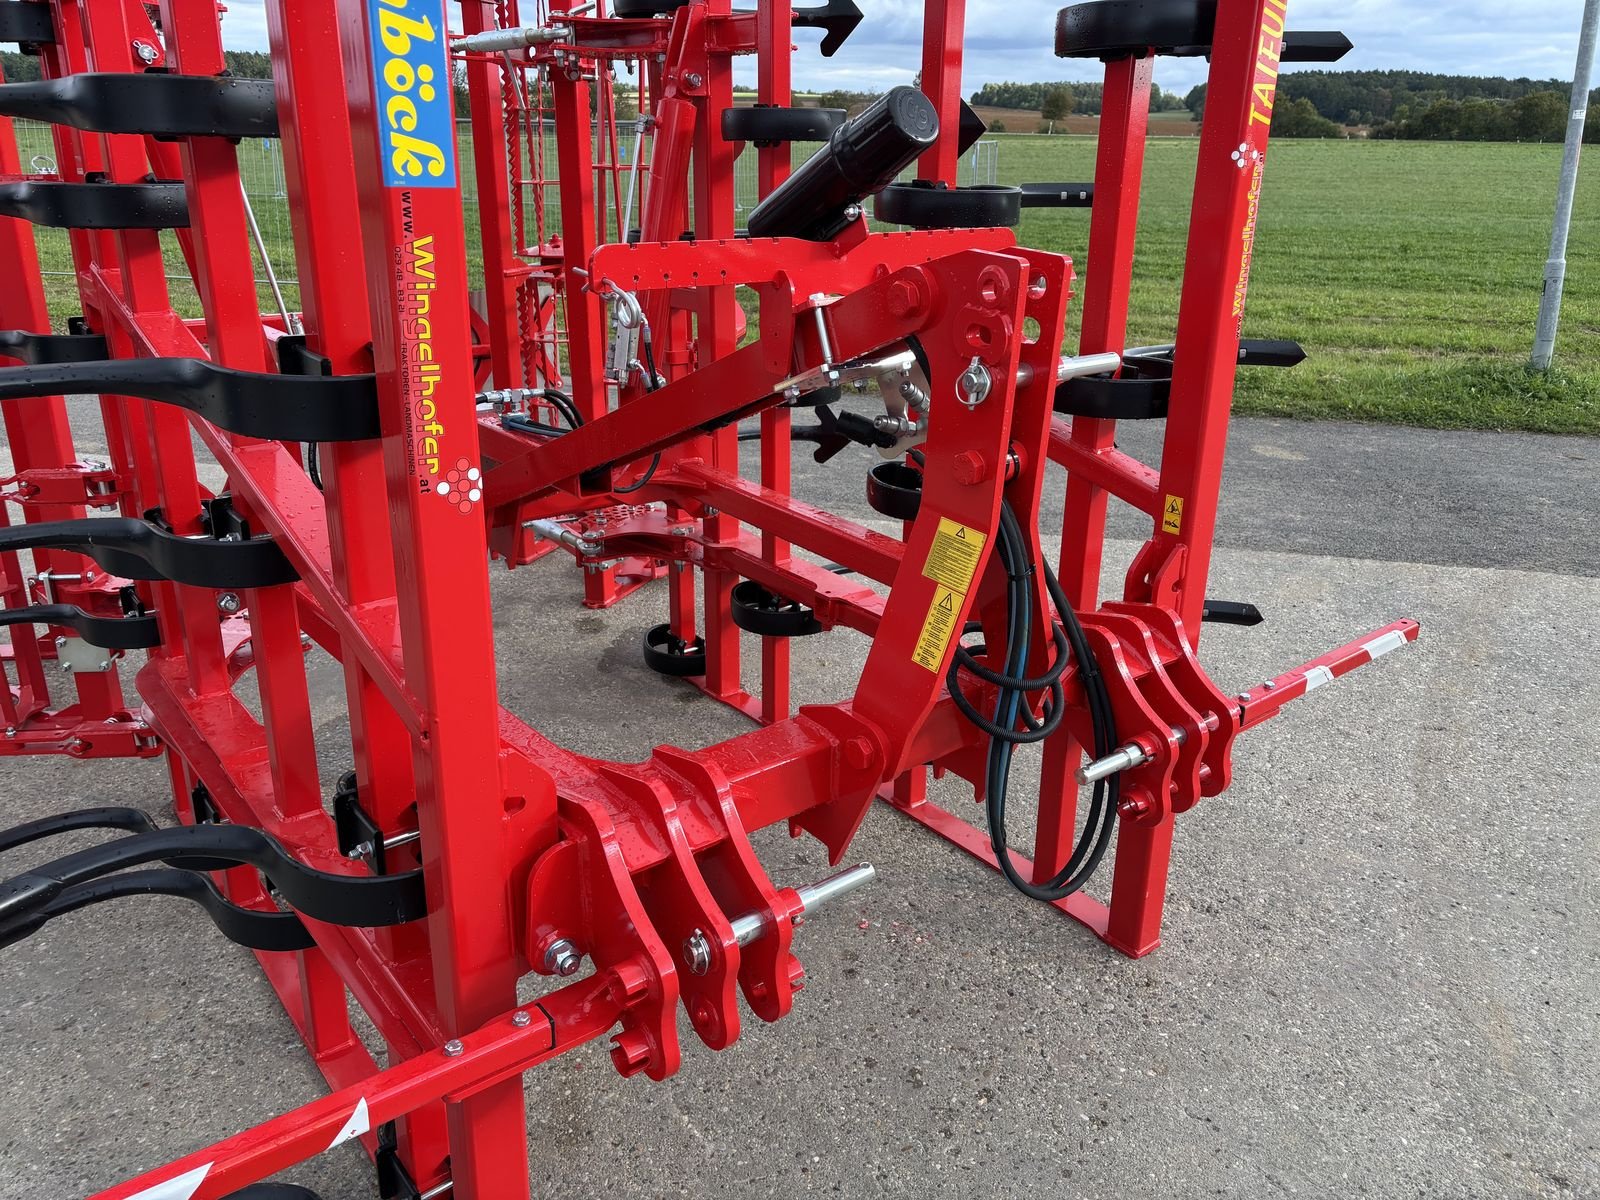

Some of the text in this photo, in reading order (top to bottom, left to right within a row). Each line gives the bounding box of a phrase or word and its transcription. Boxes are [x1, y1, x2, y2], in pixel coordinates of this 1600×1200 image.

[379, 0, 446, 177] böck
[394, 246, 402, 265] 029
[396, 268, 404, 281] 48
[398, 289, 405, 302] 83
[401, 342, 410, 396] TRAKTOREN
[404, 402, 416, 476] LANDMASCHINEN
